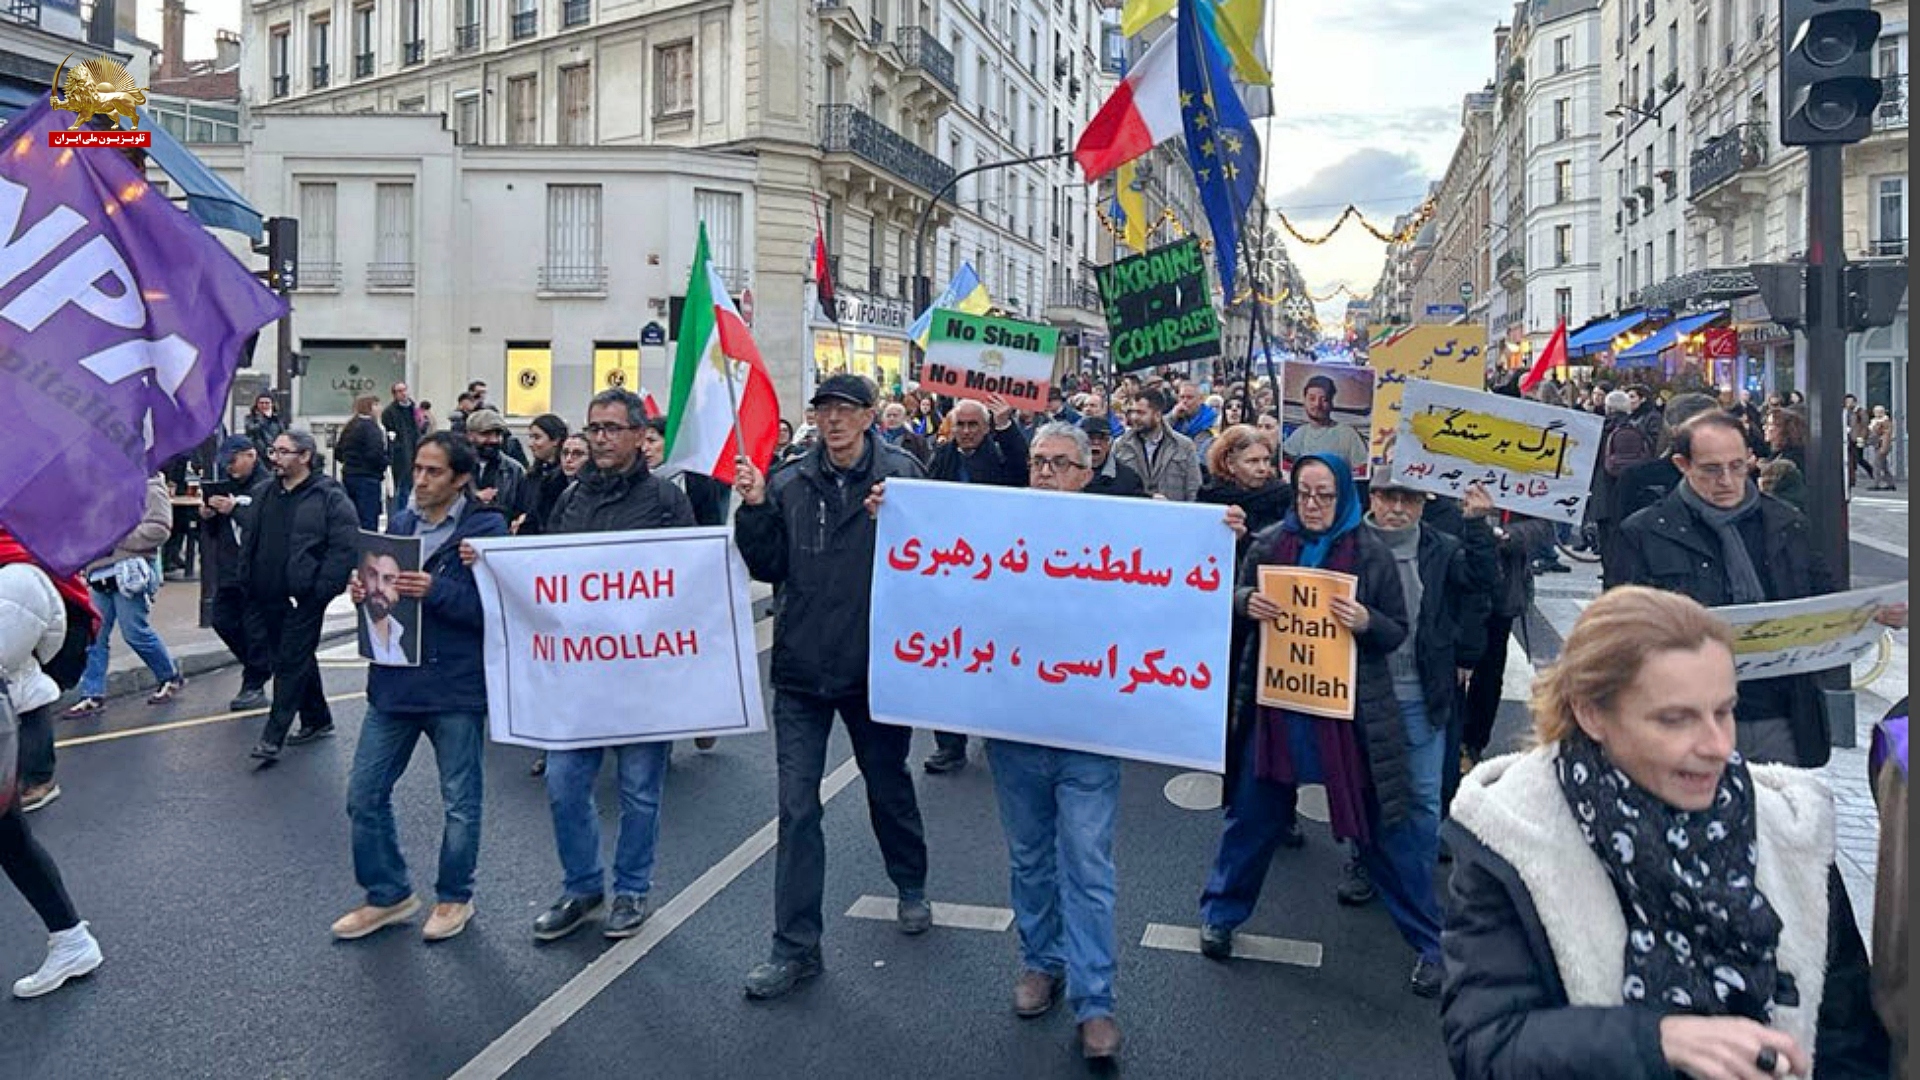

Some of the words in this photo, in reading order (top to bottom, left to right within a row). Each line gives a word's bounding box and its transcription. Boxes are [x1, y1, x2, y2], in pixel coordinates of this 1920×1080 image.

[1099, 239, 1204, 300] UKRAINE
[834, 298, 907, 329] ROIFOIRIEN
[946, 318, 976, 341] No
[983, 325, 1040, 352] Shah
[929, 364, 957, 385] No
[965, 369, 1040, 401] Mollah
[1493, 439, 1512, 453] بر
[1518, 419, 1567, 460] مرگ
[1438, 469, 1464, 490] چه
[1516, 479, 1549, 498] شاه
[888, 537, 993, 580] رهبری
[999, 538, 1030, 574] نه
[1042, 544, 1173, 587] سلطنت
[1185, 554, 1221, 592] نه
[534, 575, 568, 604] NI
[580, 568, 675, 602] CHAH
[1292, 584, 1317, 609] Ni
[1273, 611, 1337, 639] Chah
[532, 633, 556, 663] NI
[562, 630, 698, 663] MOLLAH
[894, 627, 996, 673] برابری
[1289, 642, 1316, 666] Ni
[1037, 644, 1213, 694] دمکراسی
[1265, 667, 1348, 699] Mollah
